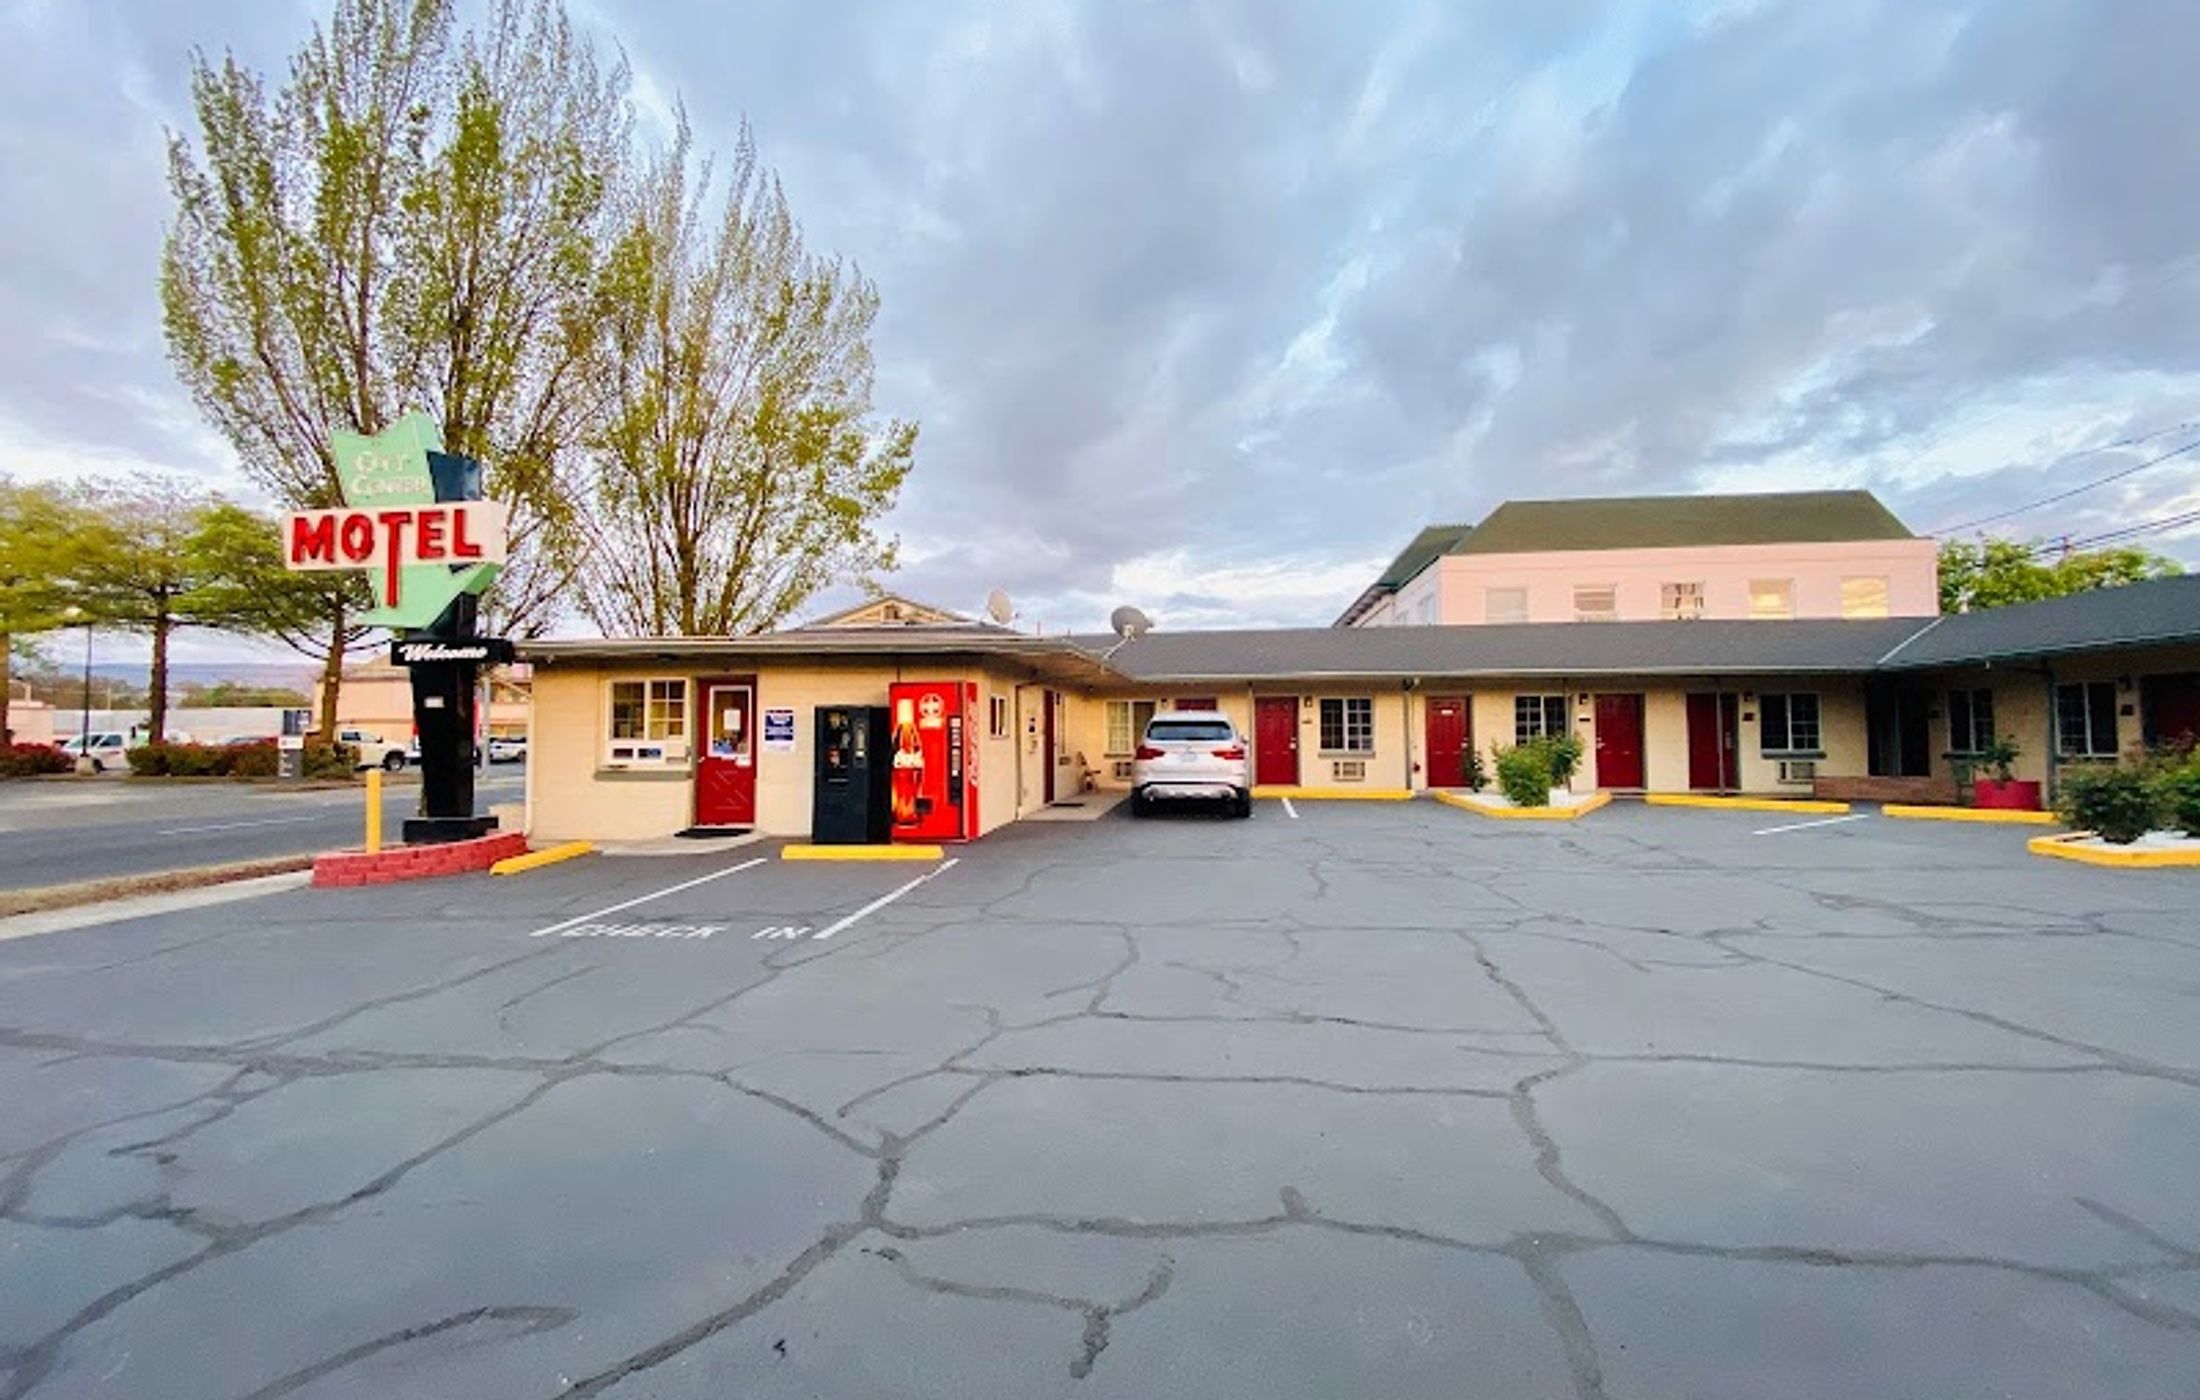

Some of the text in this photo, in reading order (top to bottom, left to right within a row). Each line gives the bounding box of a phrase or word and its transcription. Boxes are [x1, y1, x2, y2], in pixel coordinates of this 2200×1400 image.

[291, 508, 483, 609] MOTEL
[398, 643, 489, 662] Welcome
[560, 923, 813, 940] CHECK IN
